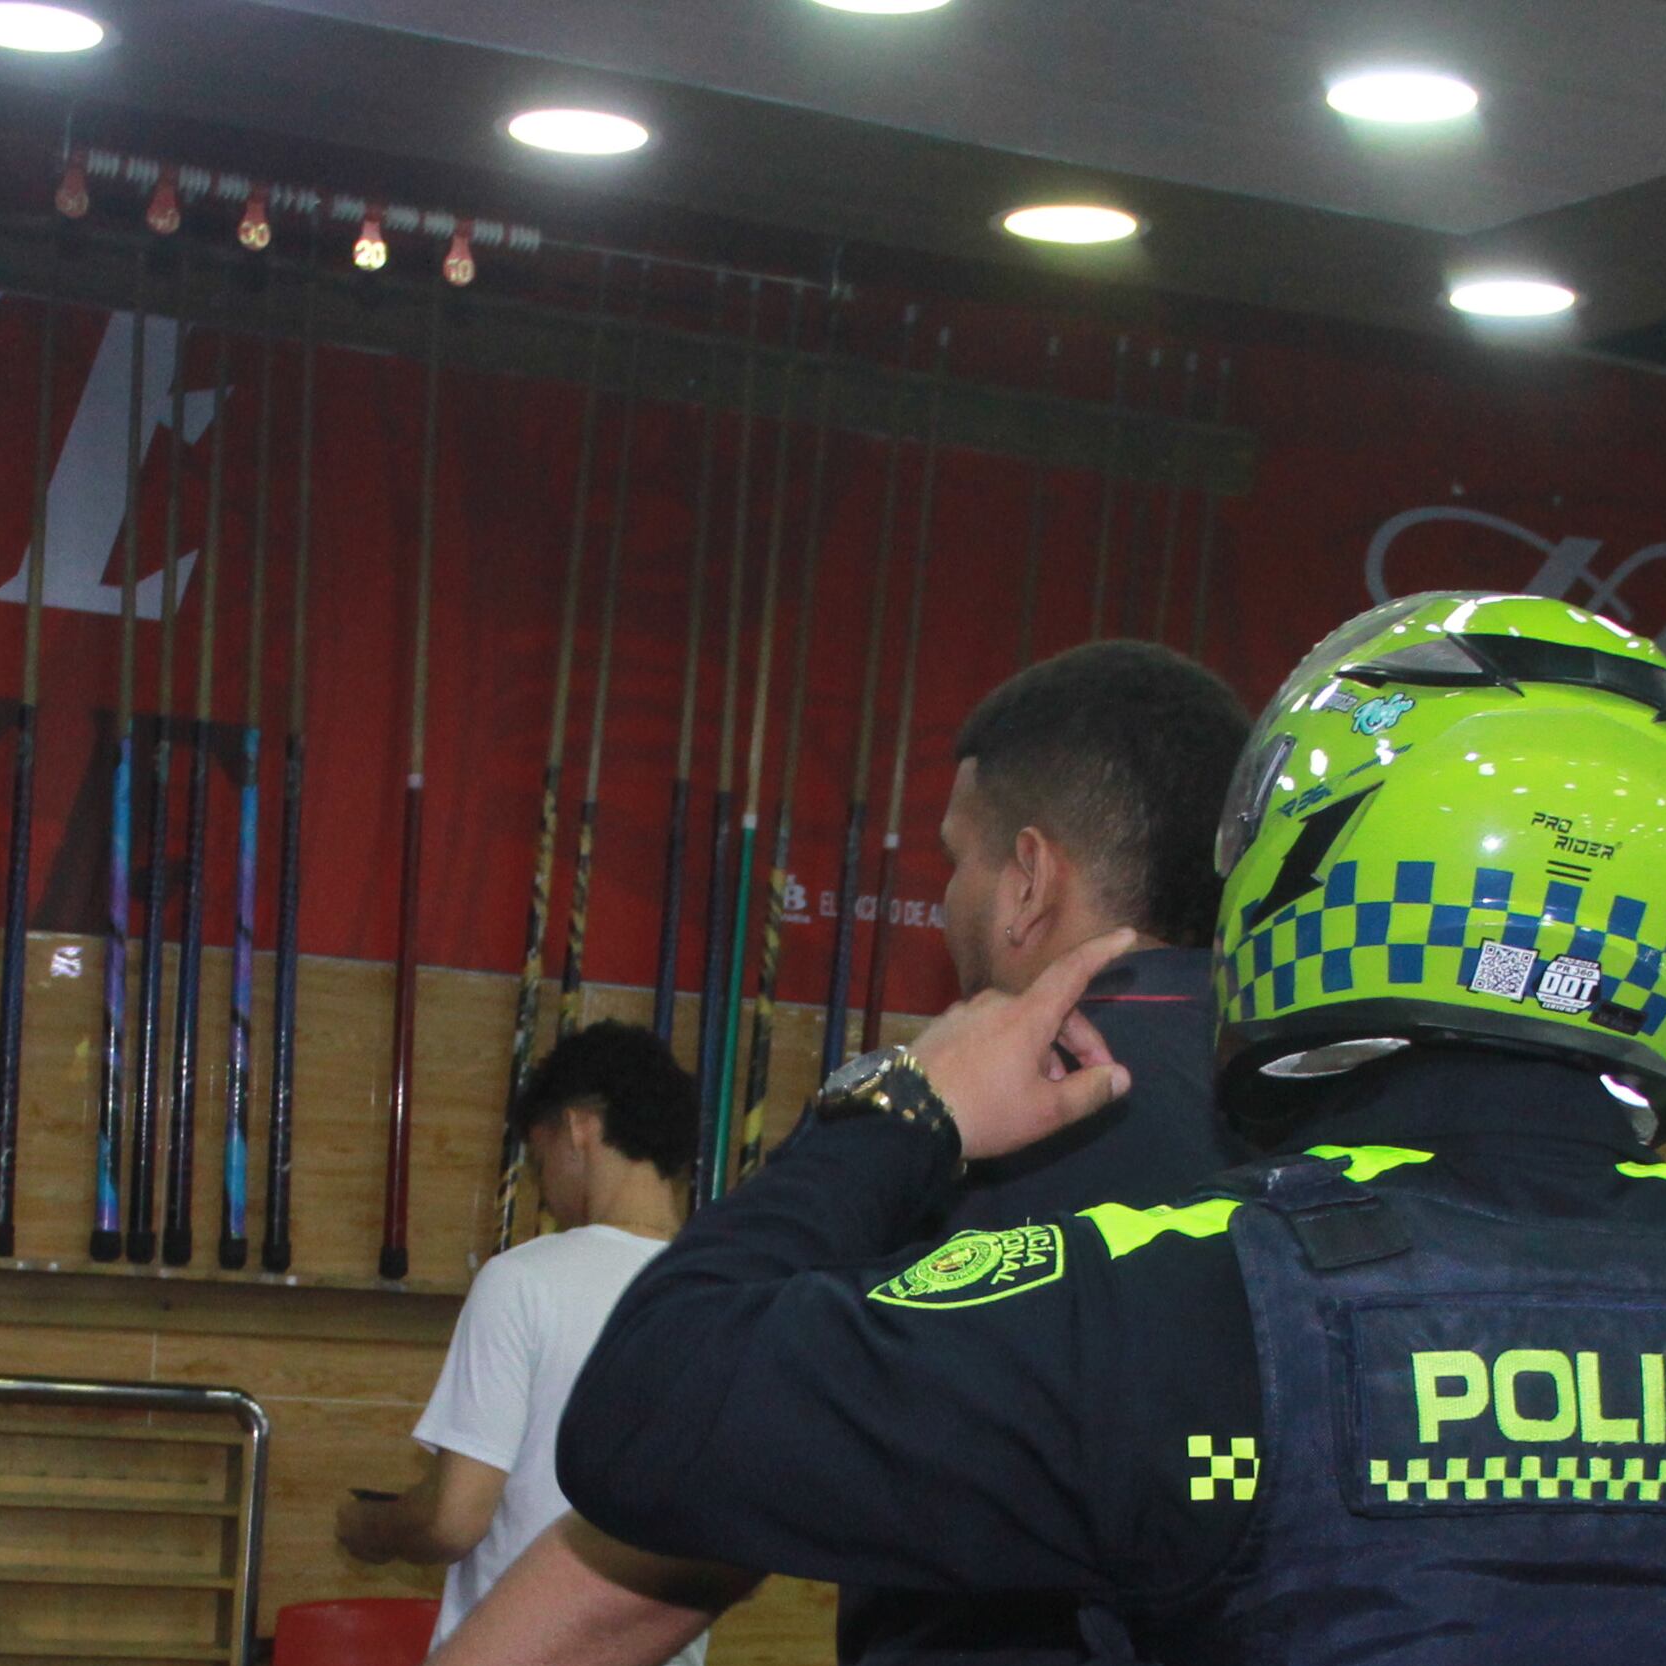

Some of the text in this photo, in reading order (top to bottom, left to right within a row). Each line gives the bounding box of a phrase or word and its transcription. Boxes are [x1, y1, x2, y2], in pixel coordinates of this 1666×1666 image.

[1531, 811, 1573, 833] PRO
[1553, 834, 1615, 860] RIDER
[1538, 972, 1600, 1001] DOT
[990, 1236, 1025, 1285] ONAL
